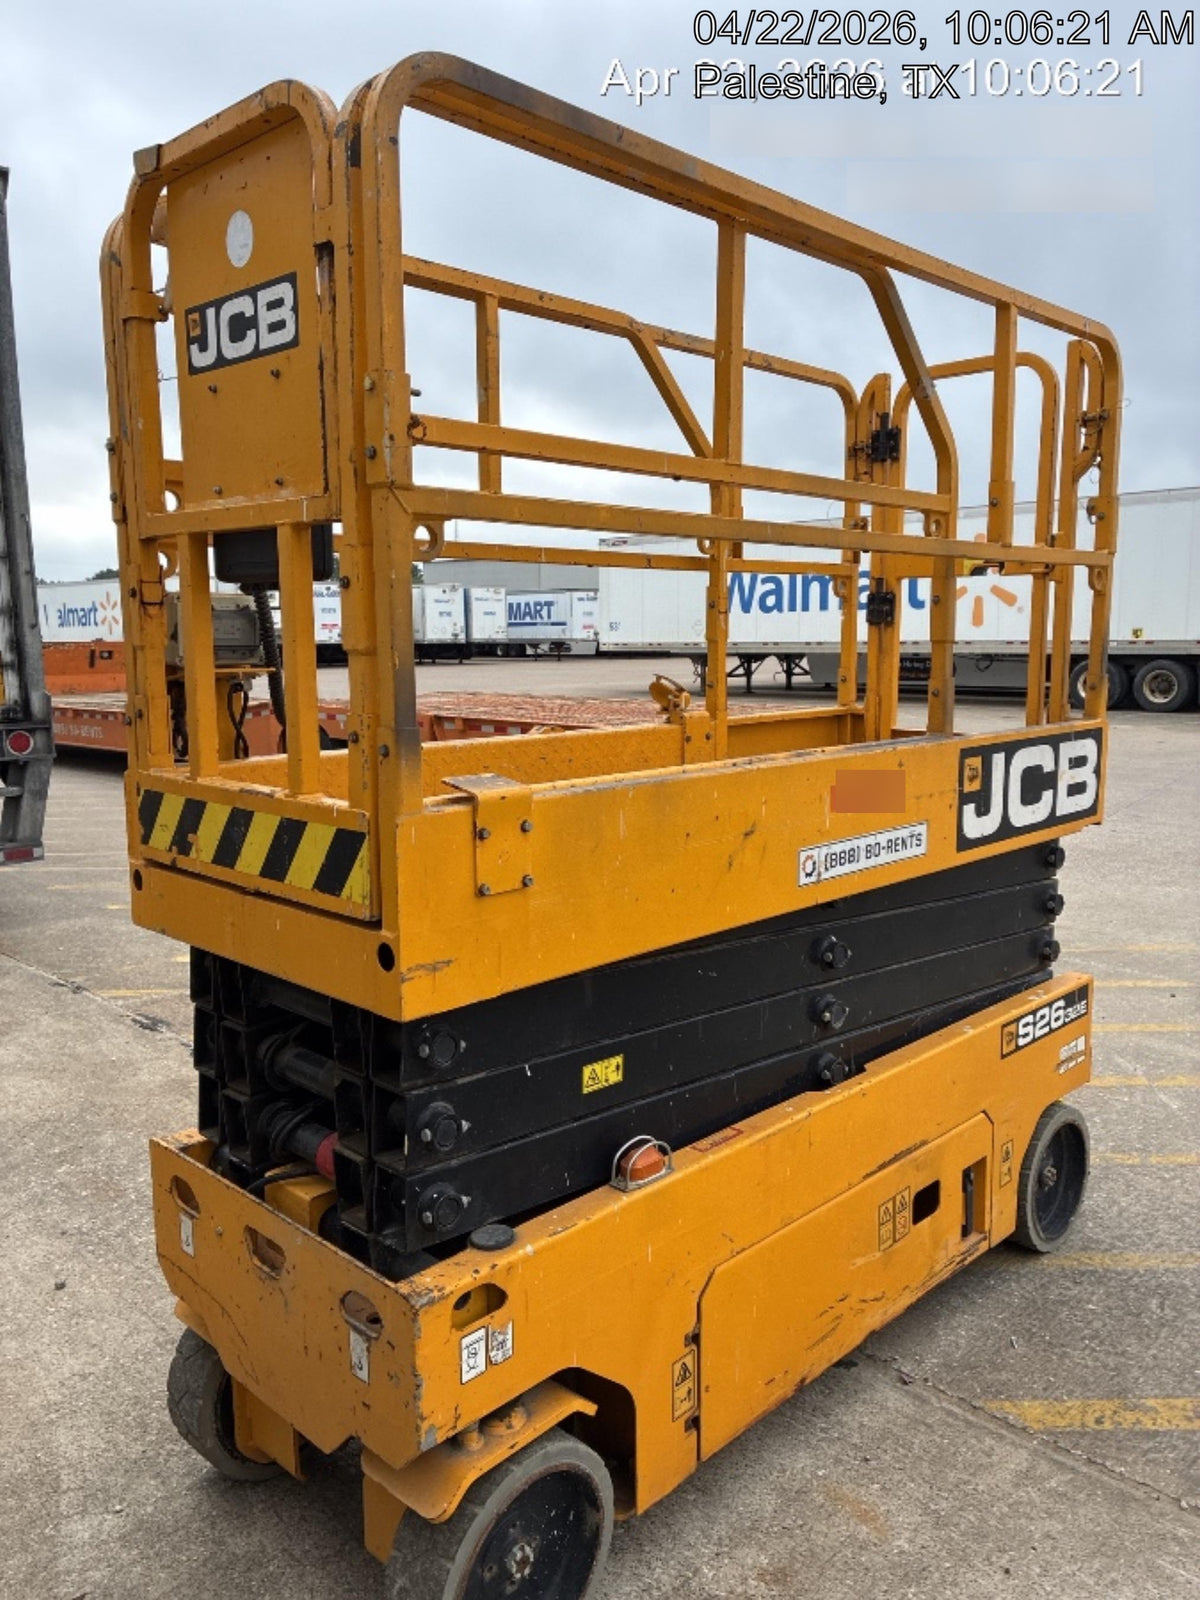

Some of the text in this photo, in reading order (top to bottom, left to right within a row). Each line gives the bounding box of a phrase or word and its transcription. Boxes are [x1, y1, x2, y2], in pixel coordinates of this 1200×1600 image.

[190, 282, 296, 368] JCB
[44, 602, 98, 627] almart
[508, 601, 554, 621] MART
[962, 737, 1098, 840] JCB
